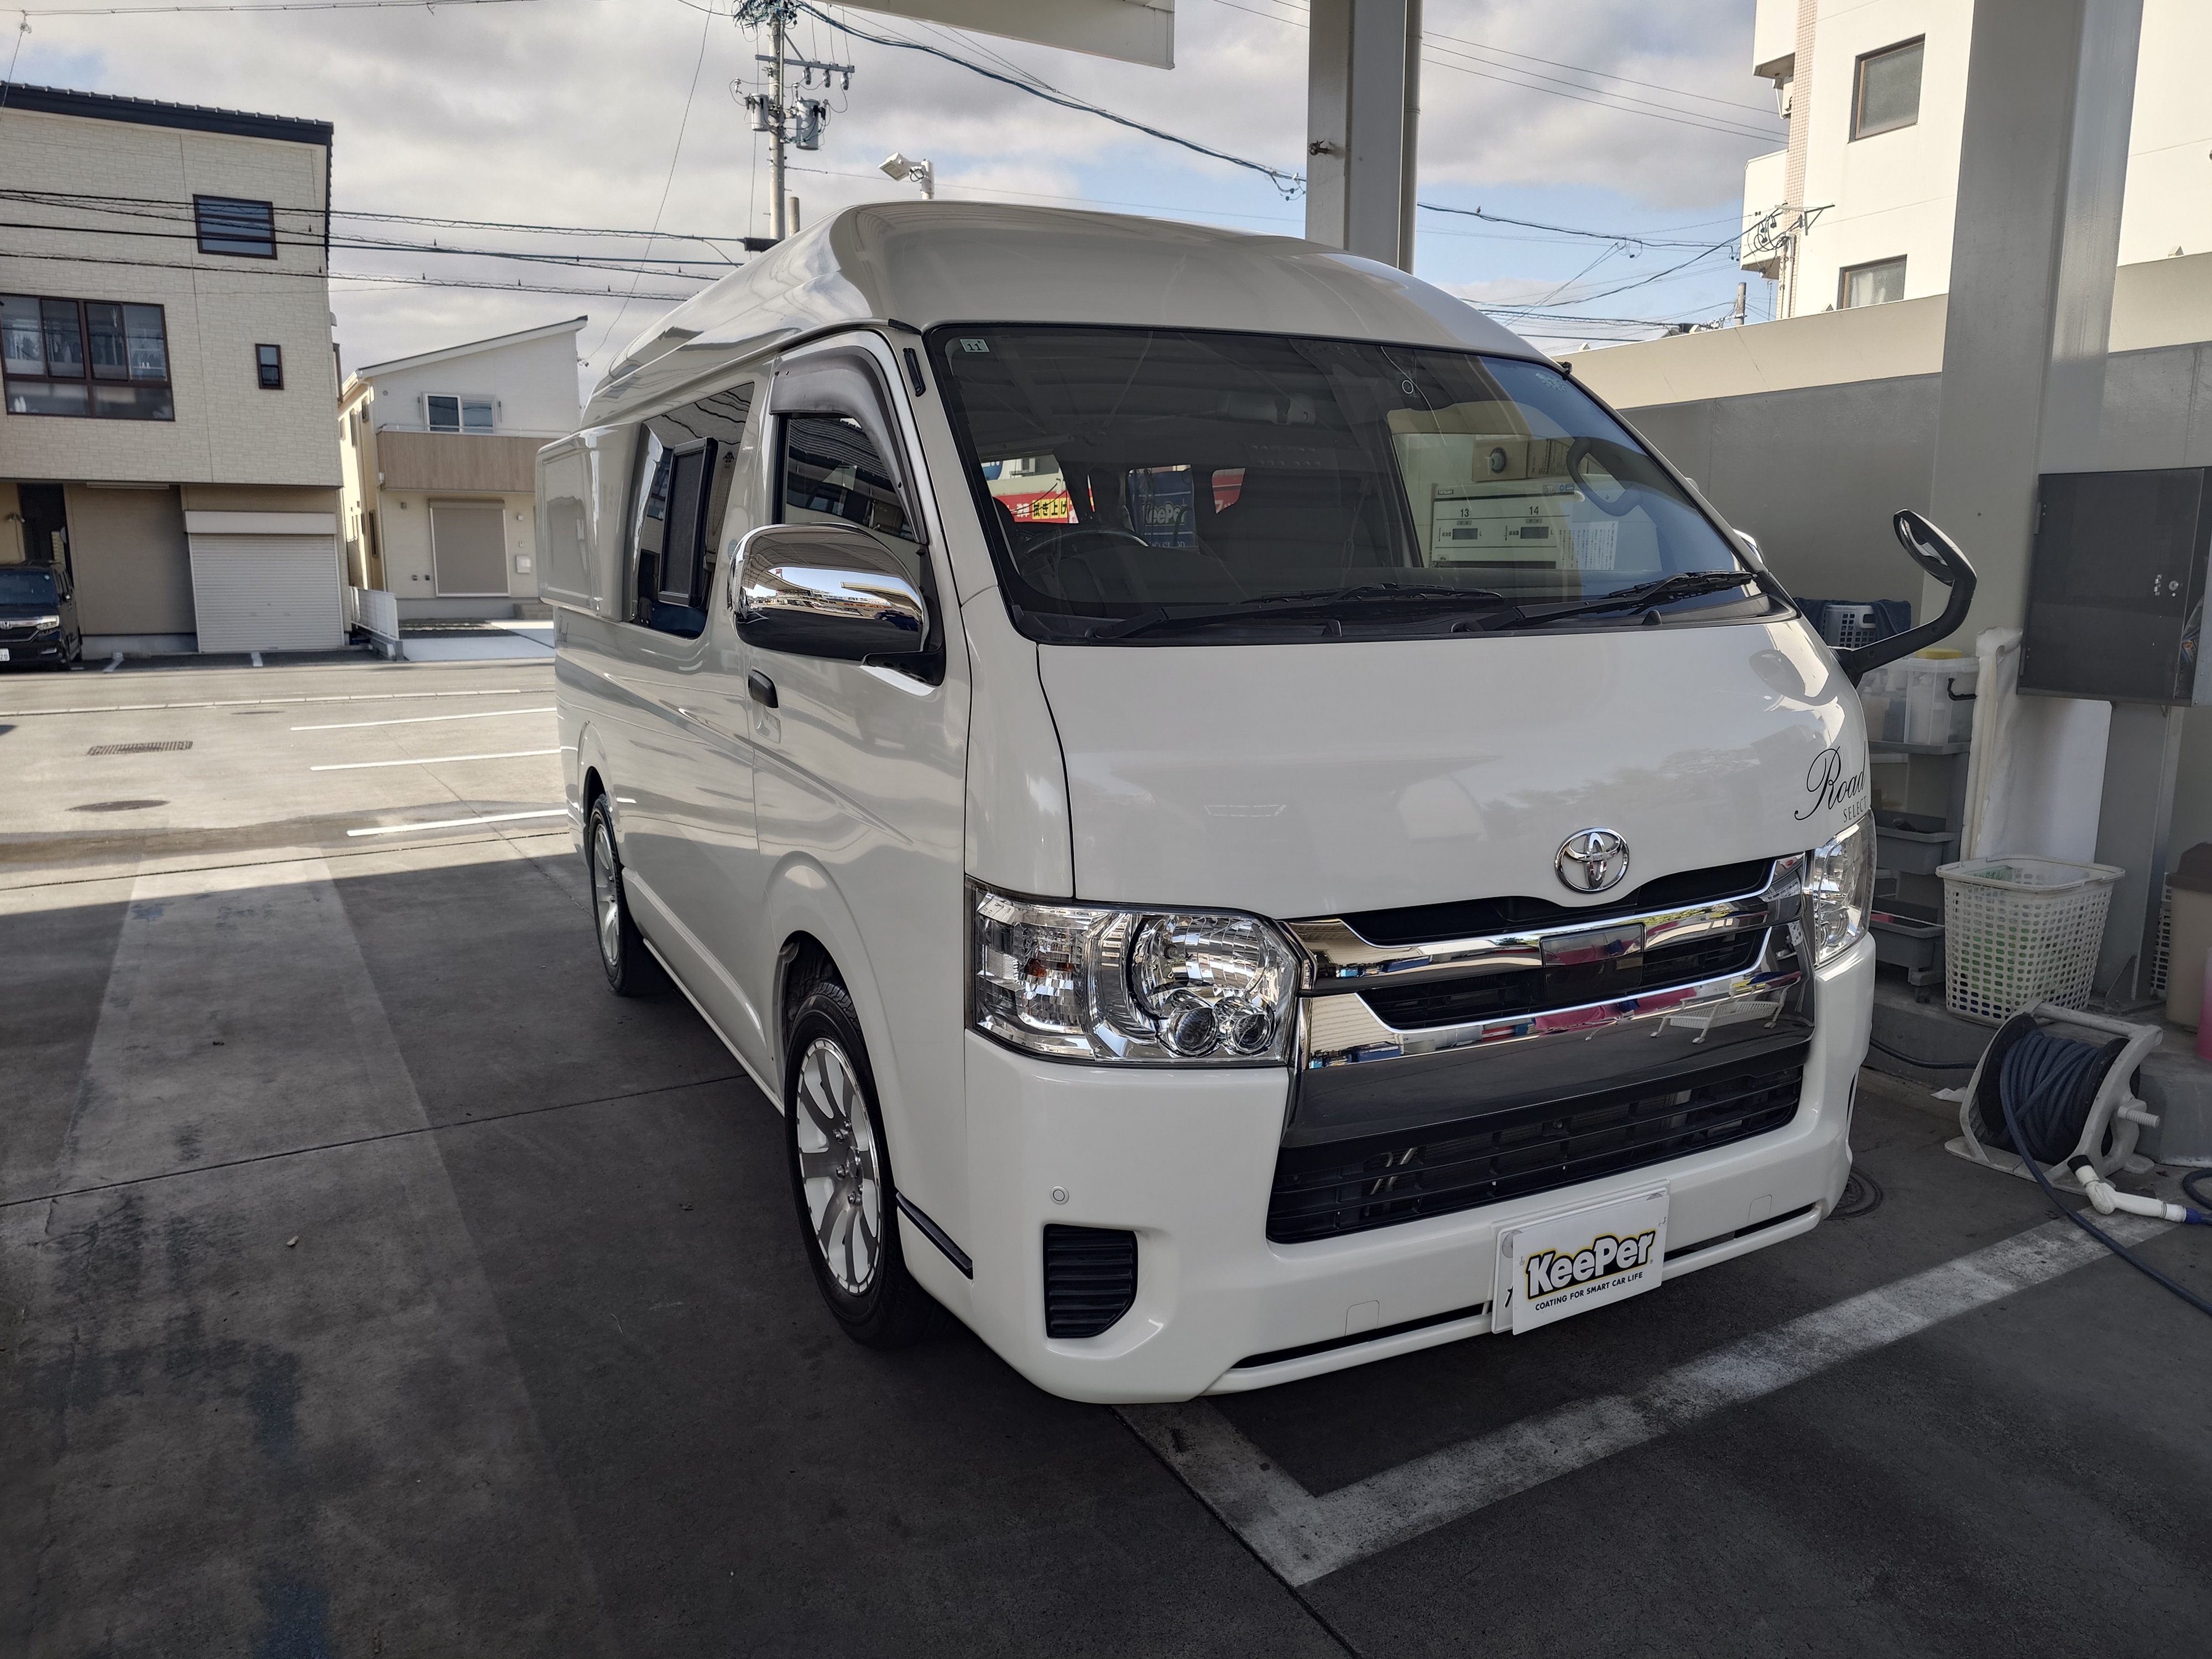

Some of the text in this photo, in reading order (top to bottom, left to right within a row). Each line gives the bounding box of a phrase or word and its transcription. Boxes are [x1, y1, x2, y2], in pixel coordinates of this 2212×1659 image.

[1460, 508, 1469, 517] 13
[1530, 506, 1539, 515] 14
[1794, 740, 1866, 821] Road
[1843, 796, 1867, 823] SELECT
[1526, 1229, 1656, 1301] KeePer
[1535, 1271, 1643, 1311] COATING FOR SMART CAR LIFE
